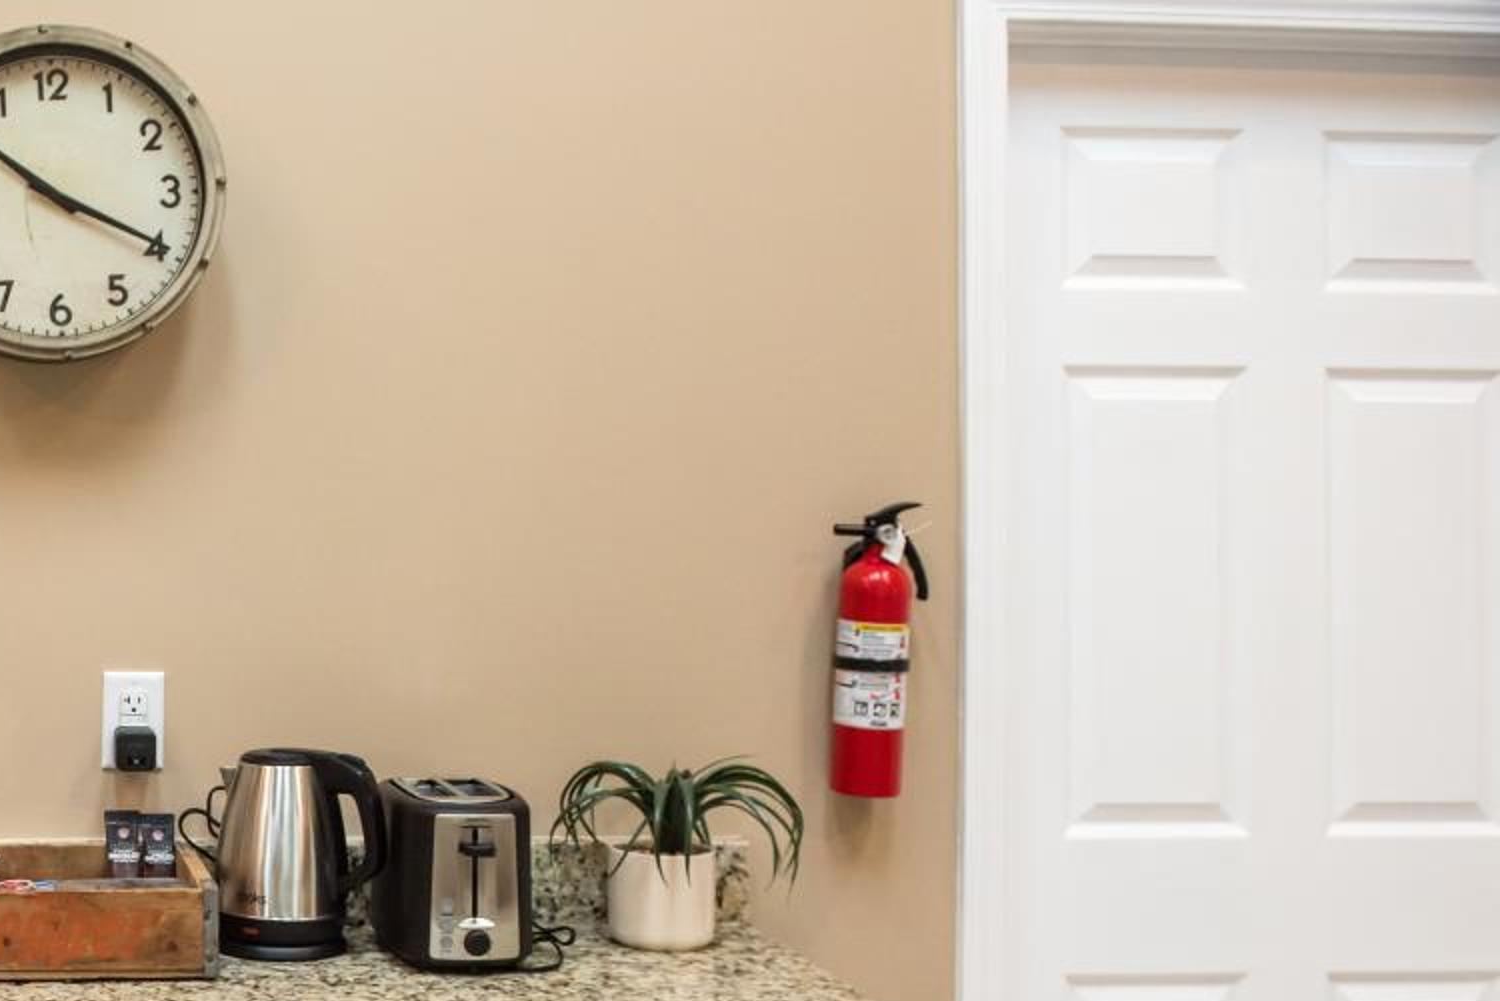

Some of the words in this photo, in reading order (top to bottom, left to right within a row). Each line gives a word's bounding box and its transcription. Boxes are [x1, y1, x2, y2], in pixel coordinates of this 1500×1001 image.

[33, 67, 69, 101] 12
[102, 82, 113, 113] 1
[139, 118, 163, 151] 2
[159, 174, 181, 208] 3
[107, 273, 129, 307] 5
[49, 292, 73, 327] 6
